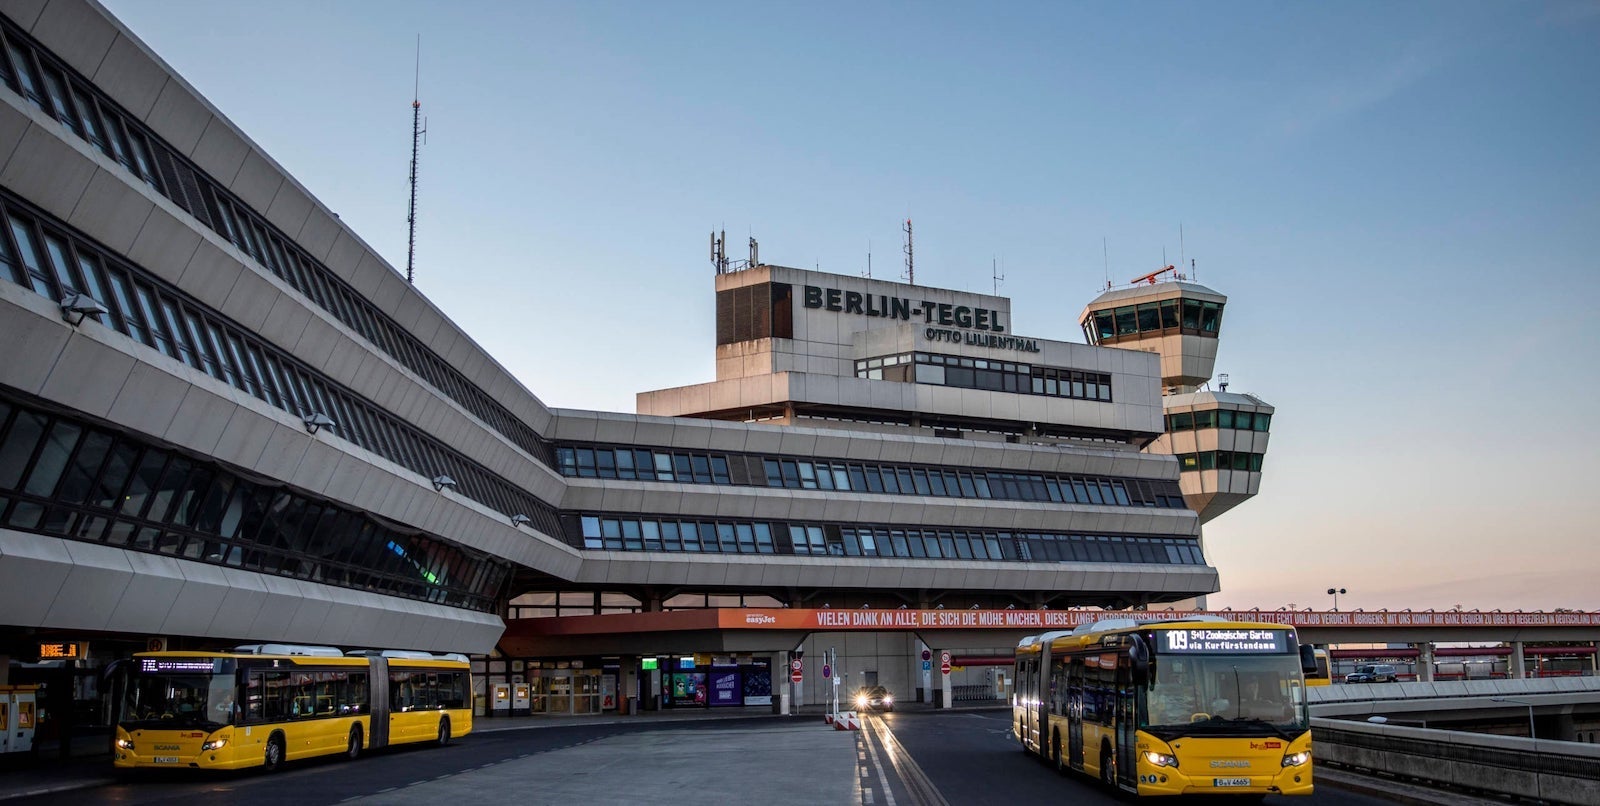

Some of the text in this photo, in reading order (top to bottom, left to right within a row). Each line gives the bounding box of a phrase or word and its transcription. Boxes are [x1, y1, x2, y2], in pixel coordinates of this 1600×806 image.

[804, 285, 1004, 332] BERLIN-TEGEL
[925, 328, 1040, 353] OTTO LILIENTHAL
[746, 616, 776, 625] easyJet
[817, 612, 850, 626] VIELEN
[853, 612, 878, 626] DANK
[880, 613, 893, 626] AN
[895, 613, 920, 627] ALLE,
[922, 613, 937, 626] DIE
[939, 613, 960, 626] SICH
[962, 613, 976, 626] DIE
[979, 611, 1004, 626] MÜHE
[1006, 613, 1043, 628] MACHEN,
[1045, 613, 1067, 626] DIESE
[1069, 613, 1095, 626] LANGE
[1276, 614, 1293, 625] ECHT
[1295, 614, 1320, 625] URLAUB
[1321, 614, 1353, 625] VERDIENT.
[1387, 614, 1398, 625] MIT
[1398, 614, 1411, 625] UNS
[1412, 614, 1433, 625] KOMMT
[1434, 614, 1444, 625] IHR
[1445, 614, 1460, 625] GANZ
[1461, 614, 1484, 625] BEQUEM
[1484, 614, 1493, 625] ZU
[1556, 614, 1590, 625] DEUTSCHLAND
[1166, 630, 1188, 650] 109
[1191, 631, 1274, 642] S+U Zoologischer Garten
[1189, 641, 1276, 650] via Kurfürstendamm
[1210, 760, 1251, 768] SCANIA
